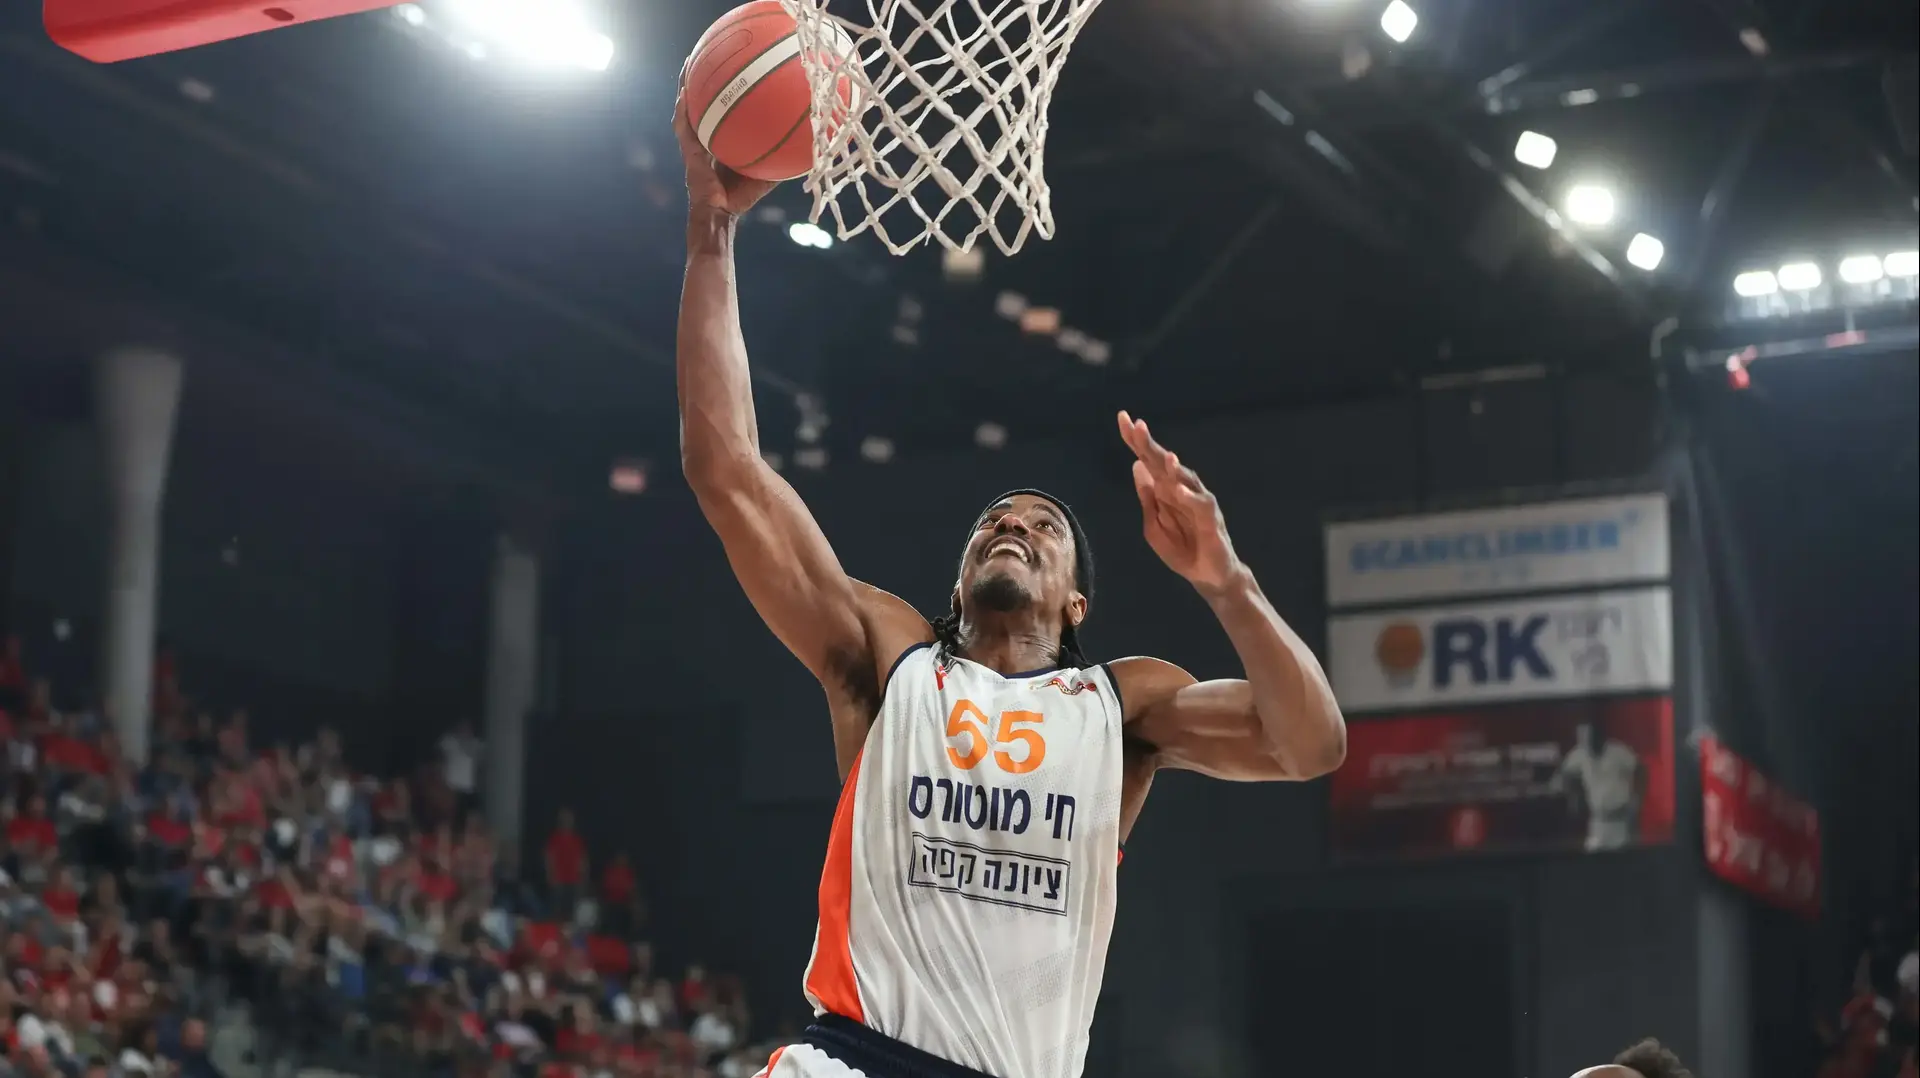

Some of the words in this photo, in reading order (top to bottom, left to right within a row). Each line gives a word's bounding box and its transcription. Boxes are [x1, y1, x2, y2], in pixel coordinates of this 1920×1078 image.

[1433, 612, 1554, 690] RK
[945, 699, 1046, 774] 55
[909, 775, 1031, 835] מוטורס
[1045, 793, 1076, 841] חי
[921, 843, 976, 886] קפה
[984, 859, 1061, 900] ציונה
